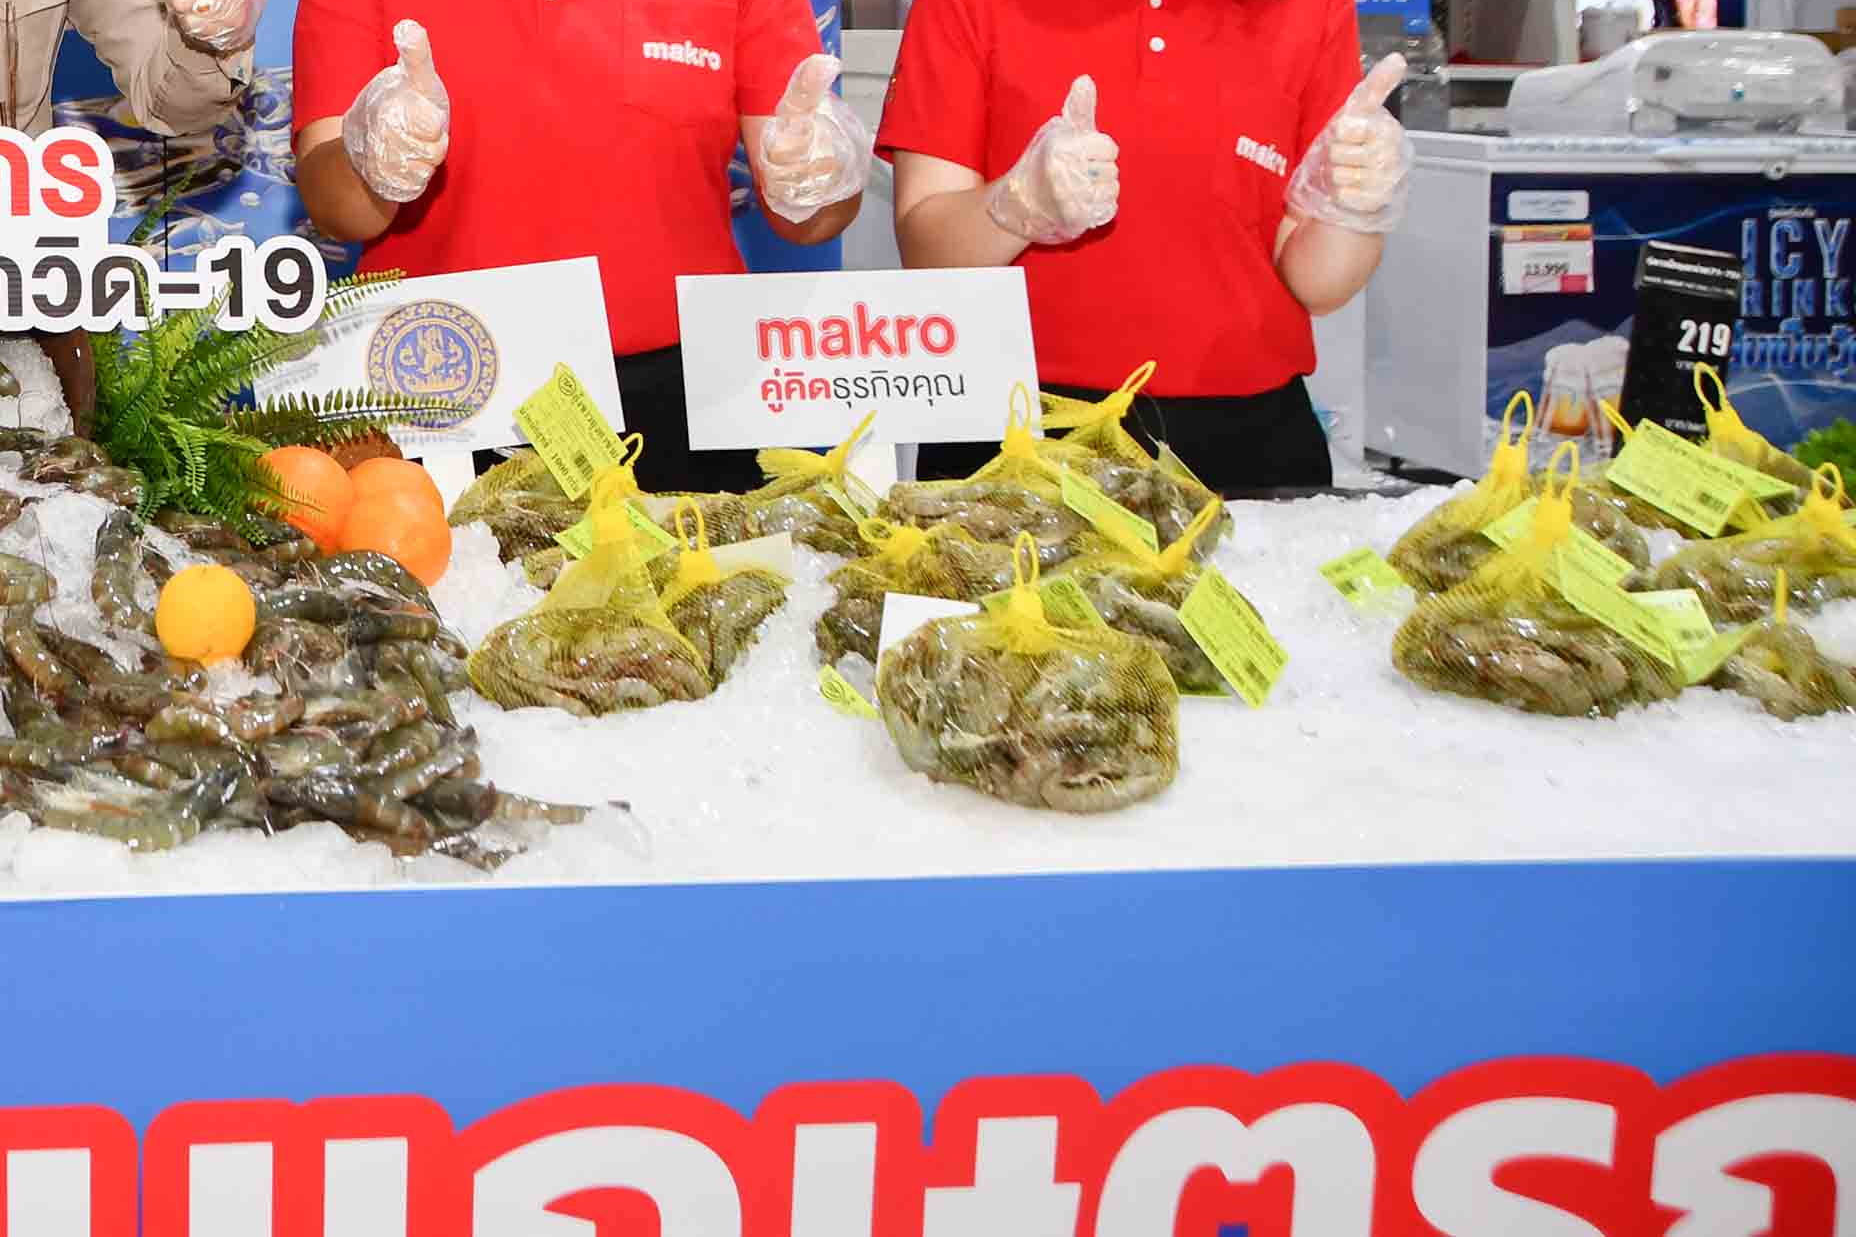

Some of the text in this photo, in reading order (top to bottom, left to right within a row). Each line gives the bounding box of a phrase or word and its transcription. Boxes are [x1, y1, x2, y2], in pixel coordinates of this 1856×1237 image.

[643, 39, 721, 71] makro
[757, 302, 957, 359] makro
[1677, 319, 1732, 356] 219
[761, 367, 964, 412] คู่คิดธุรกิจคุณ
